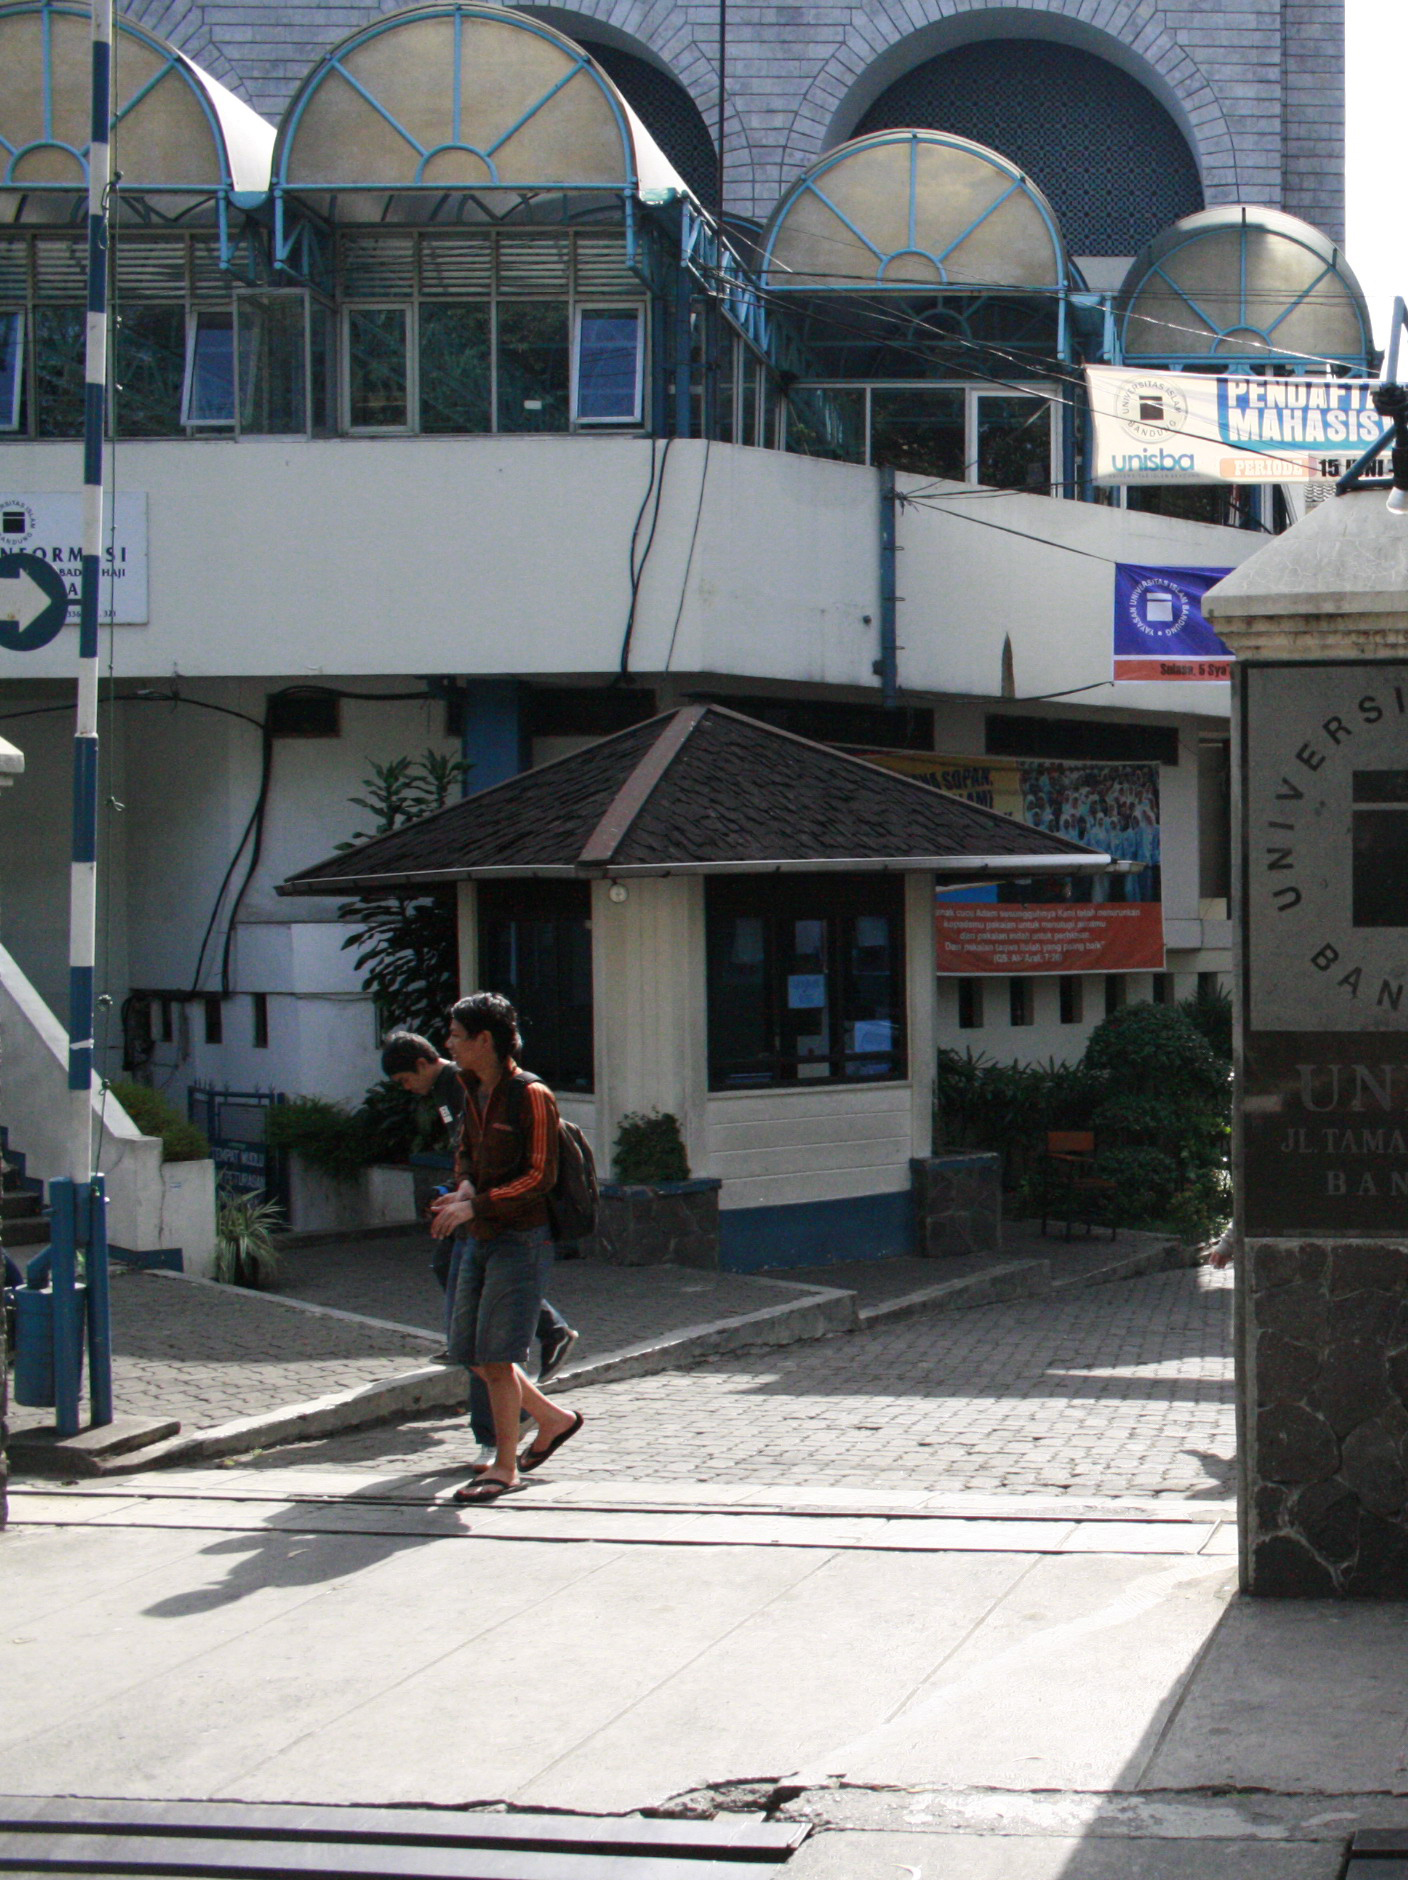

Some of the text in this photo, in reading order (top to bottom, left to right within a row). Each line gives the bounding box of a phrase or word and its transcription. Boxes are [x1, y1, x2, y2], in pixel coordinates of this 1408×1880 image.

[1111, 448, 1195, 472] unisba
[1233, 458, 1303, 476] PERIODE
[1319, 459, 1340, 477] 15
[102, 568, 126, 579] HAJI
[1129, 578, 1169, 606] UNIVERSITAS
[1169, 581, 1189, 603] ISLAM
[1129, 606, 1154, 636] YAYASAN
[1198, 663, 1205, 676] 5
